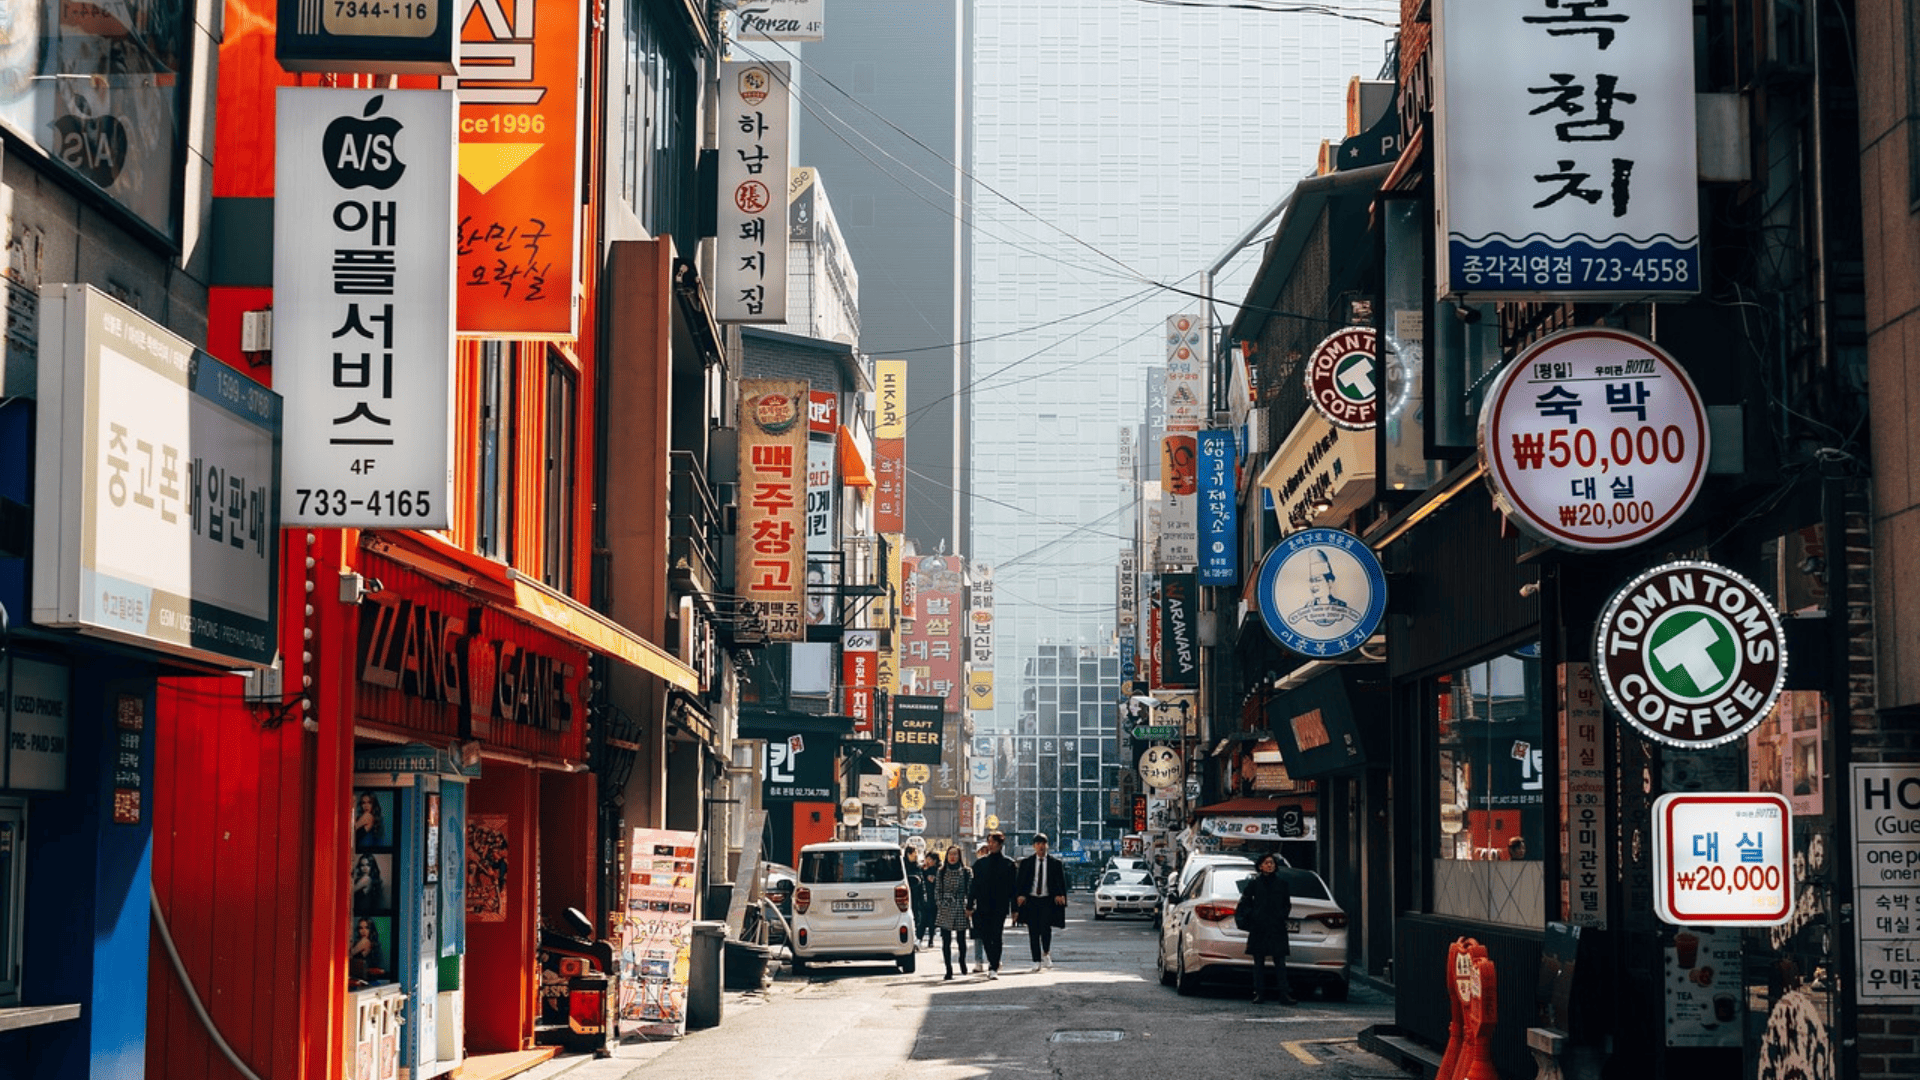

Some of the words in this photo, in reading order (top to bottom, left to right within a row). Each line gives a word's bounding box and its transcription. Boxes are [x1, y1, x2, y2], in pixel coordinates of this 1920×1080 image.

[334, 1, 427, 20] 7344-116
[740, 8, 801, 33] Forza
[806, 21, 822, 32] 4F
[337, 133, 393, 171] A/S
[1462, 256, 1573, 284] 종각직영점
[1580, 258, 1690, 283] 723-4558
[329, 201, 397, 445] 애플서비스
[1315, 340, 1345, 381] TOM
[1624, 359, 1656, 374] HOTEL
[884, 373, 897, 428] HIKARI
[1320, 388, 1376, 421] COFF
[1535, 382, 1653, 426] 숙박
[1511, 425, 1684, 473] ₩50,000
[350, 459, 376, 475] 4F
[107, 421, 266, 559] 중고폰매입판매
[808, 490, 830, 513] 0계
[1570, 475, 1634, 500] 대실
[296, 488, 430, 517] 733-4165
[1558, 500, 1654, 529] ₩20,000
[750, 445, 796, 593] 맥주창고
[1610, 582, 1667, 656] TOM
[1668, 573, 1696, 602] N
[1702, 575, 1775, 665] TOMS
[974, 623, 992, 662] 보신탕
[1168, 598, 1193, 674] ARAWARA
[500, 640, 573, 732] GAMES
[15, 695, 35, 713] USED
[36, 698, 63, 717] PHONE
[1620, 673, 1764, 736] COFFEE
[895, 731, 939, 745] BEER
[903, 720, 933, 728] CRAFT
[1579, 725, 1595, 766] 대실
[369, 757, 407, 771] BOOTH
[1579, 808, 1598, 912] 우미관호텔
[1692, 831, 1763, 863] 대실
[1866, 850, 1904, 864] one
[1677, 865, 1780, 895] ₩20,000
[1875, 894, 1909, 911] 숙박
[1876, 917, 1910, 934] 대실
[1882, 948, 1920, 963] TEL.
[1676, 992, 1693, 1001] TEA
